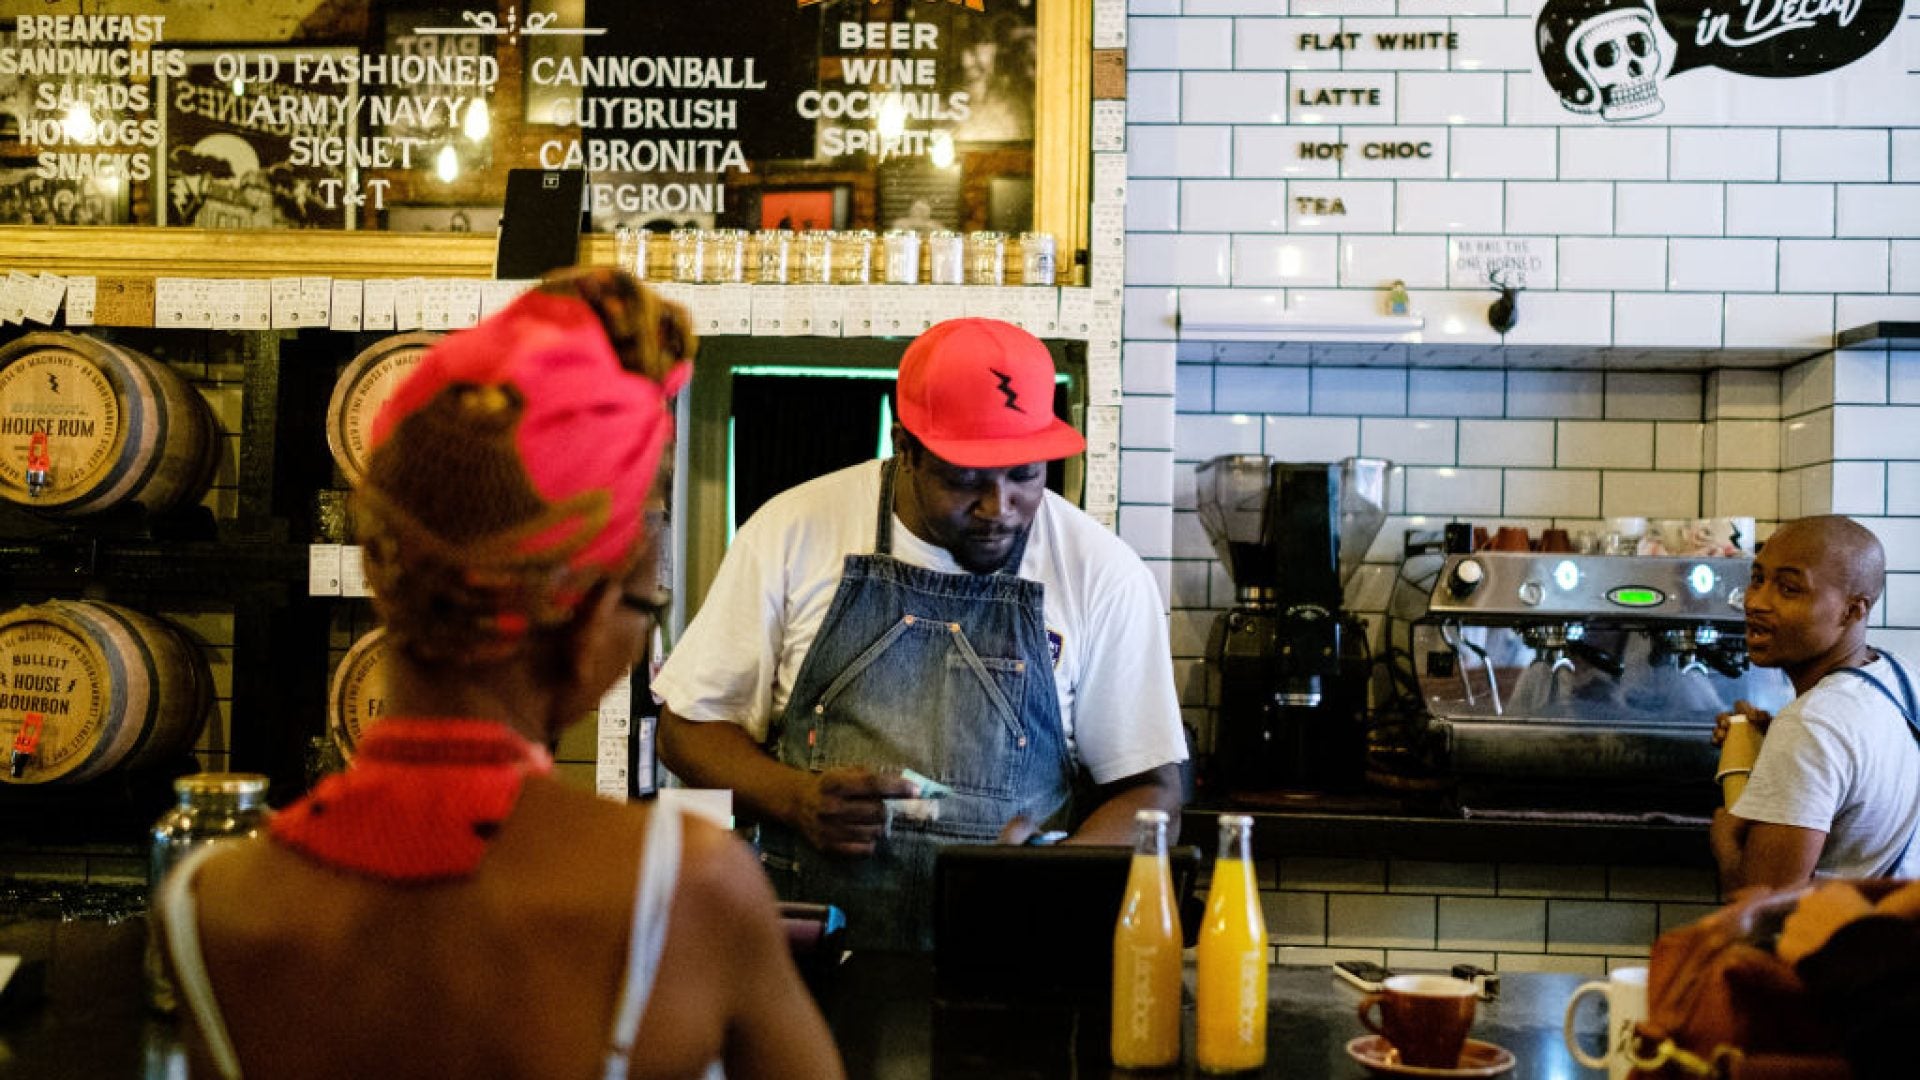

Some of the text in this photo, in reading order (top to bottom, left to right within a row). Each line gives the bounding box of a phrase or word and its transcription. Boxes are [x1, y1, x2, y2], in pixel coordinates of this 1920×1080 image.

[16, 14, 166, 42] BREAKFAST
[839, 22, 938, 50] BEER
[1297, 32, 1460, 51] FLAT WHITE
[0, 48, 187, 77] SANDWICHES
[213, 53, 499, 85] OLD FASHIONED
[531, 56, 767, 89] CANNONBALL
[841, 58, 936, 85] WINE
[35, 83, 149, 111] SALADS
[1296, 87, 1381, 106] LATTE
[246, 94, 466, 128] ARMY/NAVY
[552, 97, 738, 129] GUYBRUSH
[289, 136, 417, 169] SIGNET
[539, 139, 750, 173] CABRONITA
[1297, 142, 1433, 160] HOT CHOC
[37, 151, 150, 181] SNACKS
[318, 178, 391, 210] T&T
[1295, 196, 1347, 216] TEA
[2, 417, 95, 438] HOUSE RUM
[12, 654, 69, 670] BULLEIT
[14, 673, 62, 693] HOUSE
[0, 693, 70, 715] BOURBON
